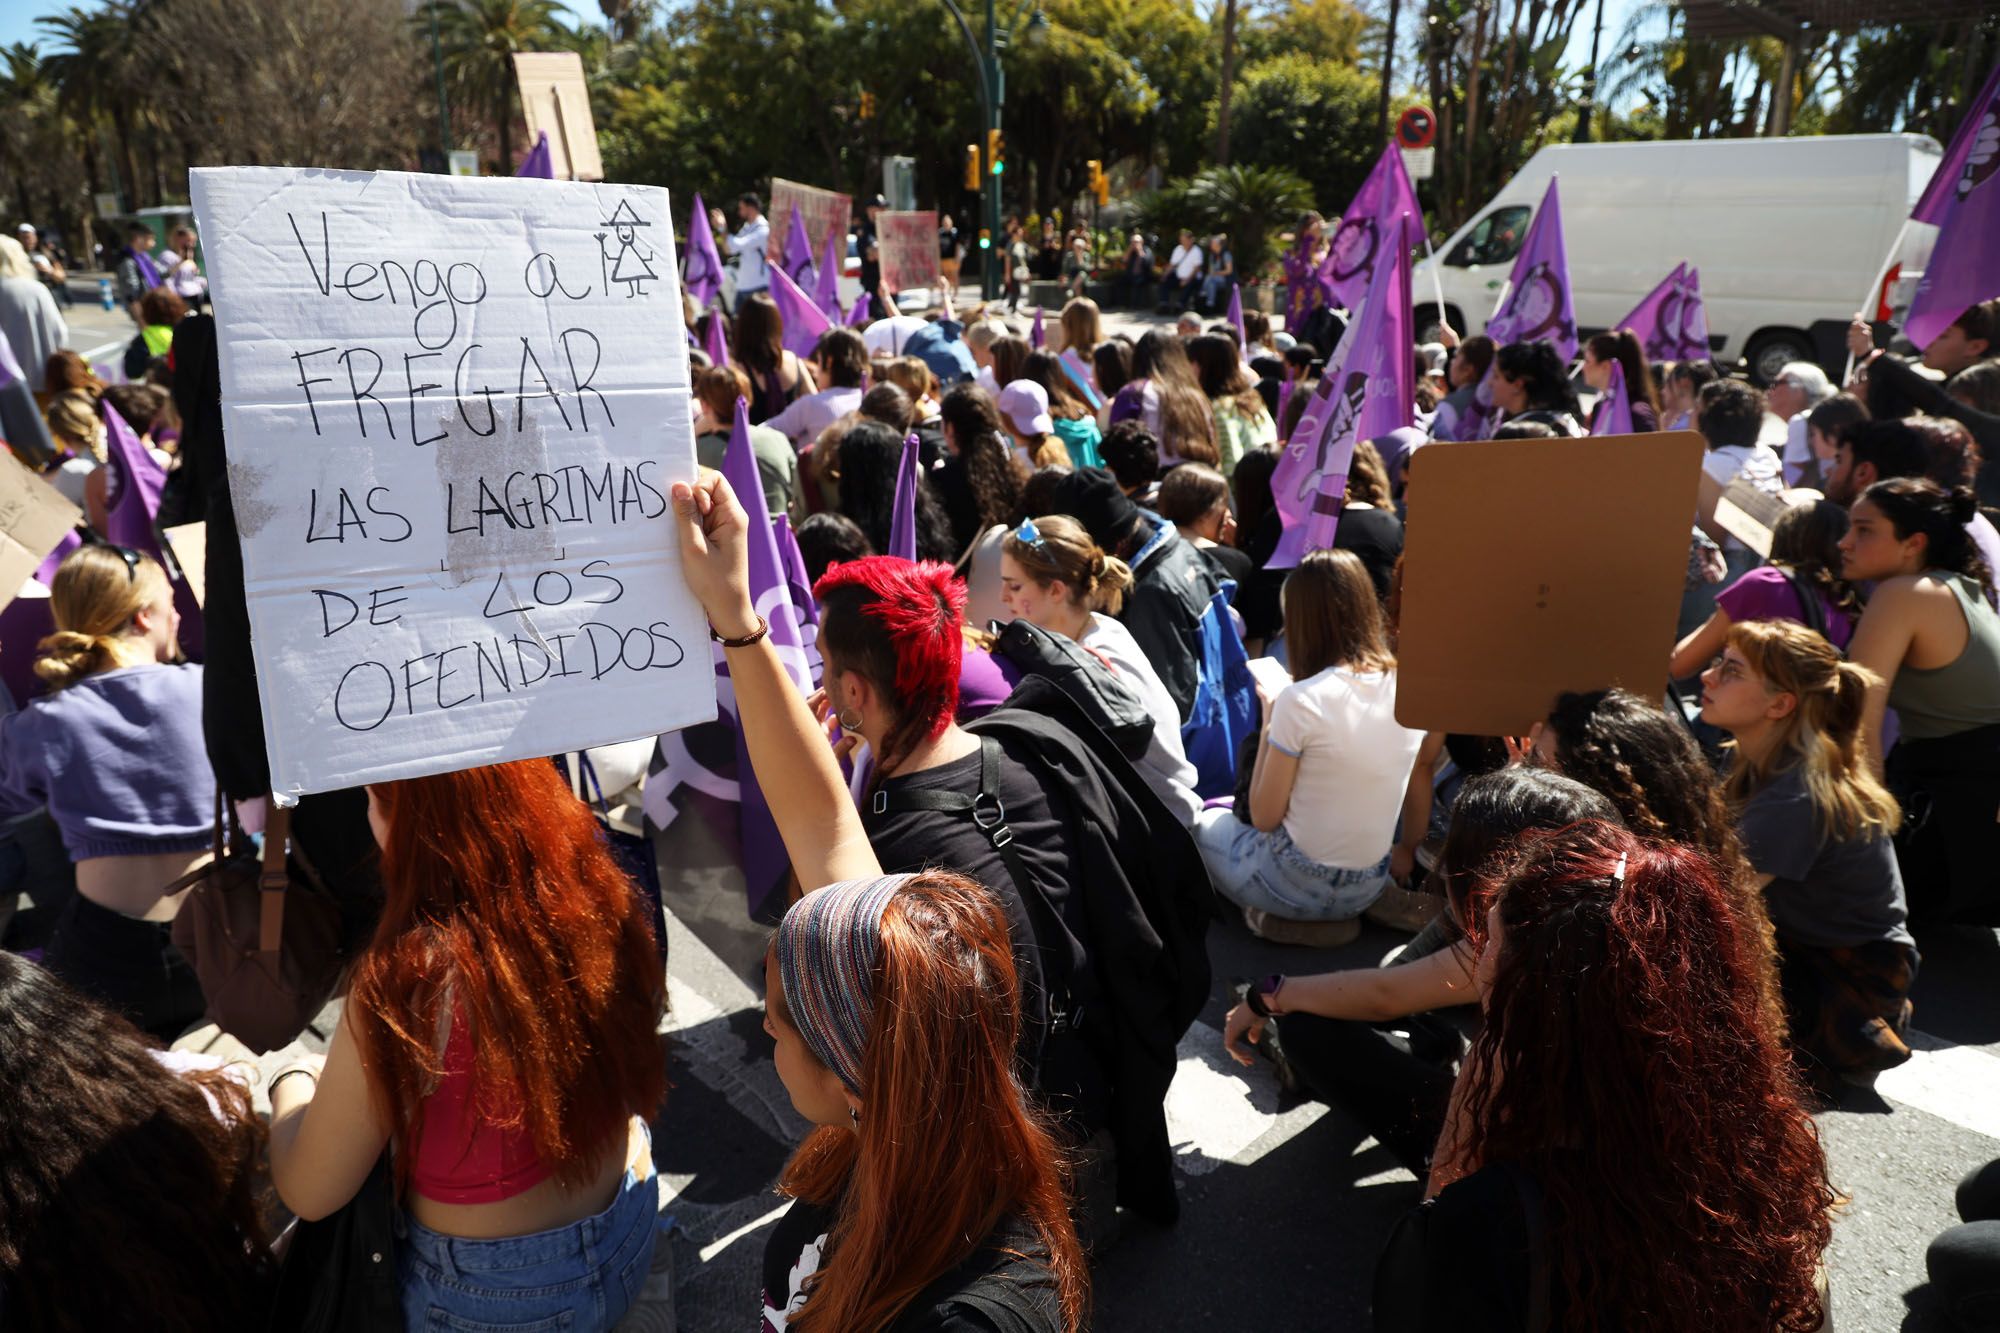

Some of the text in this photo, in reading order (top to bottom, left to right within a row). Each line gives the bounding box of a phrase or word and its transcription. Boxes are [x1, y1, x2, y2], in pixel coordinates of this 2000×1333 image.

[286, 211, 592, 351] Vengo a
[292, 327, 615, 447] FREGAR
[305, 460, 667, 544] LAS LAGRIMAS
[310, 559, 624, 638] DE LOS
[333, 620, 685, 731] OFENDIDOS
